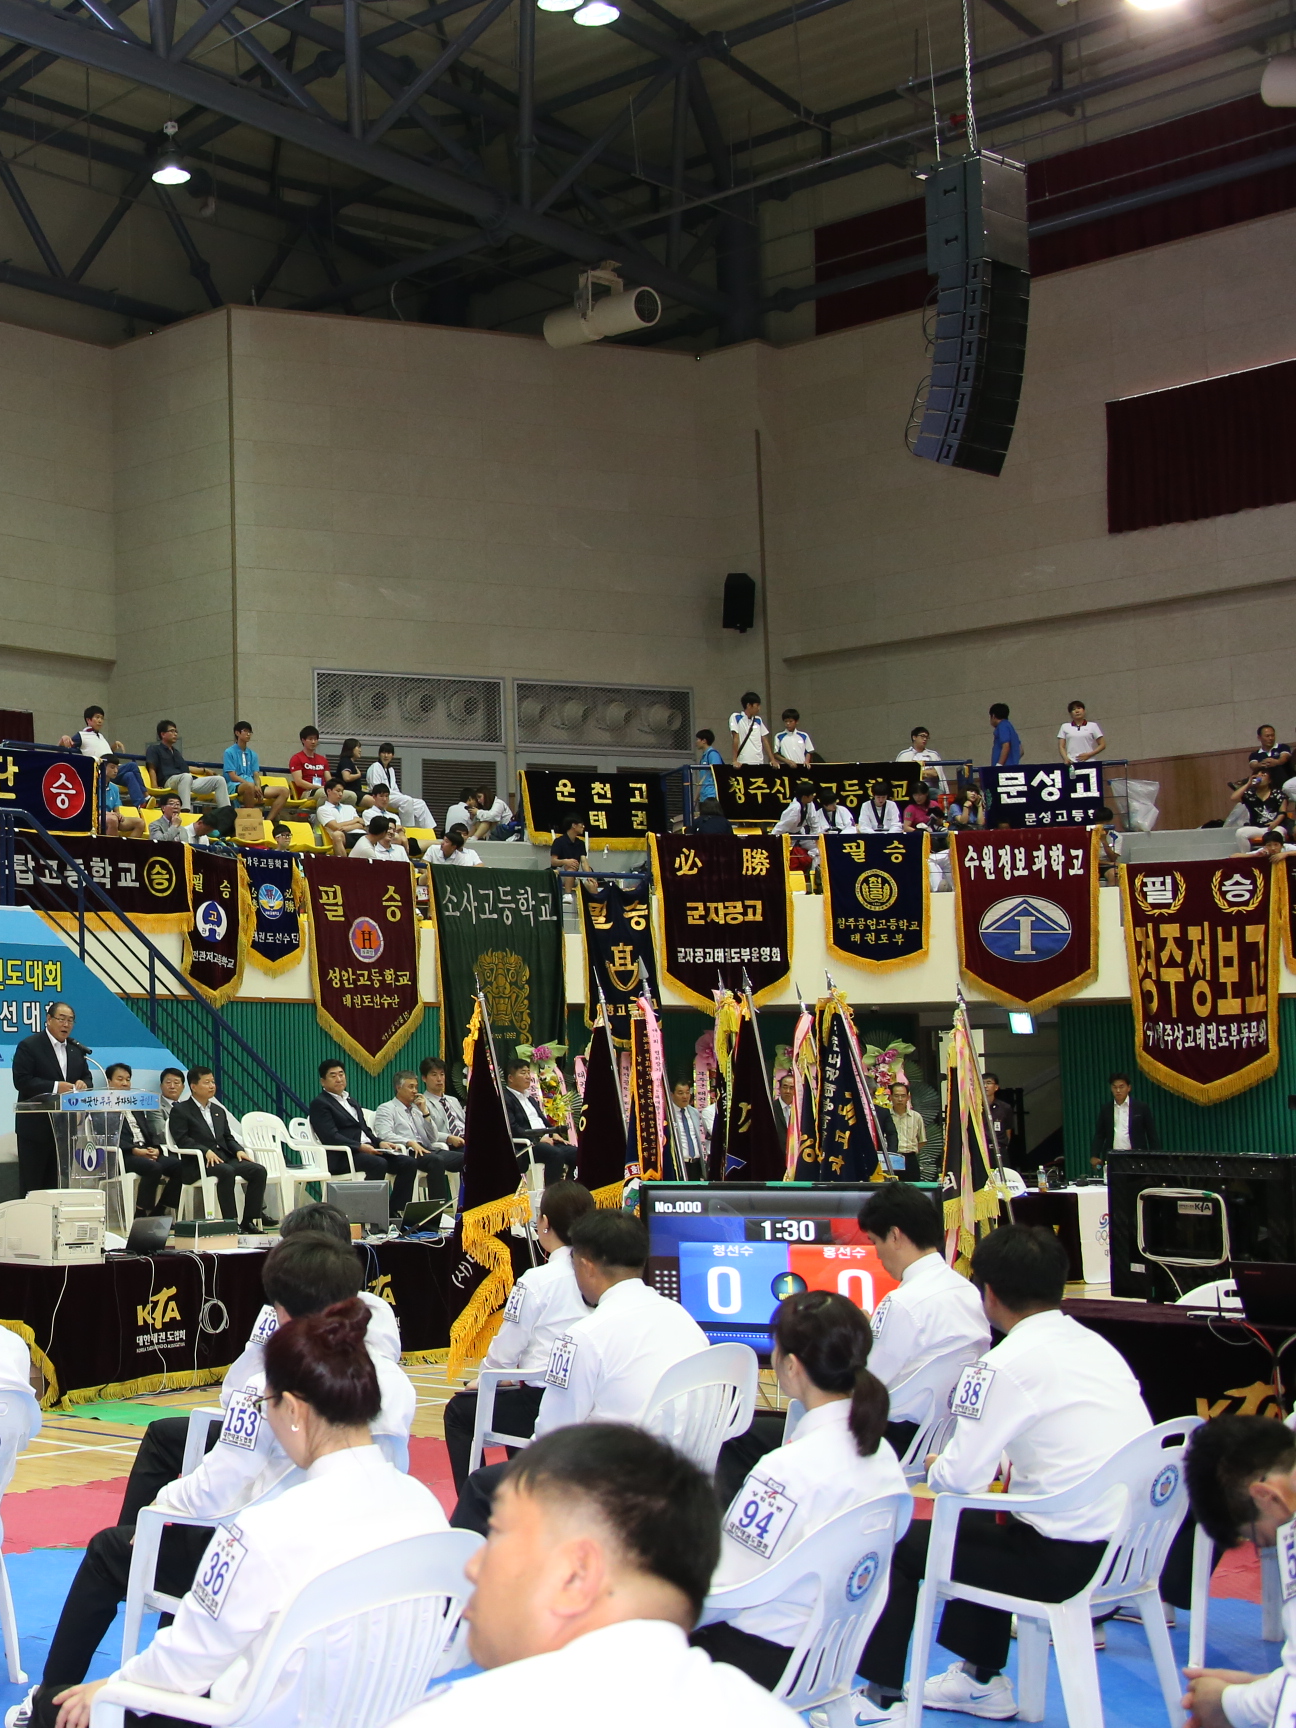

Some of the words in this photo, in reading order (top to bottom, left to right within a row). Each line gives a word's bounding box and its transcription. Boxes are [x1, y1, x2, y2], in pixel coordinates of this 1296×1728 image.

[50, 772, 77, 810] 승
[555, 779, 649, 804] 운천고
[996, 767, 1100, 805] 문성고
[674, 848, 703, 876] 必
[742, 848, 771, 876] 勝
[842, 840, 866, 863] 필
[883, 841, 906, 863] 승
[964, 844, 1084, 881] 수원정보과학고
[150, 864, 171, 890] 승
[219, 880, 232, 898] 승
[1142, 875, 1173, 903] 필
[1221, 873, 1253, 902] 승
[318, 884, 346, 922] 필
[381, 885, 403, 922] 승
[442, 883, 559, 927] 소사고등학교
[686, 900, 764, 925] 군자공고
[327, 967, 412, 988] 성안고등학교
[1135, 921, 1268, 1018] 경주정보고
[342, 994, 400, 1009] 태권도선수단
[655, 1201, 702, 1214] No.000
[761, 1220, 816, 1242] 1:30
[712, 1245, 754, 1258] 청선수
[822, 1246, 866, 1259] 홍선수
[707, 1266, 742, 1315] 0
[784, 1276, 794, 1294] 1
[837, 1268, 874, 1315] 0
[137, 1286, 182, 1329] KTA
[259, 1317, 277, 1338] 49
[550, 1352, 571, 1378] 104
[960, 1380, 982, 1406] 38
[224, 1407, 258, 1437] 153
[738, 1499, 775, 1540] 94
[203, 1551, 230, 1596] 36
